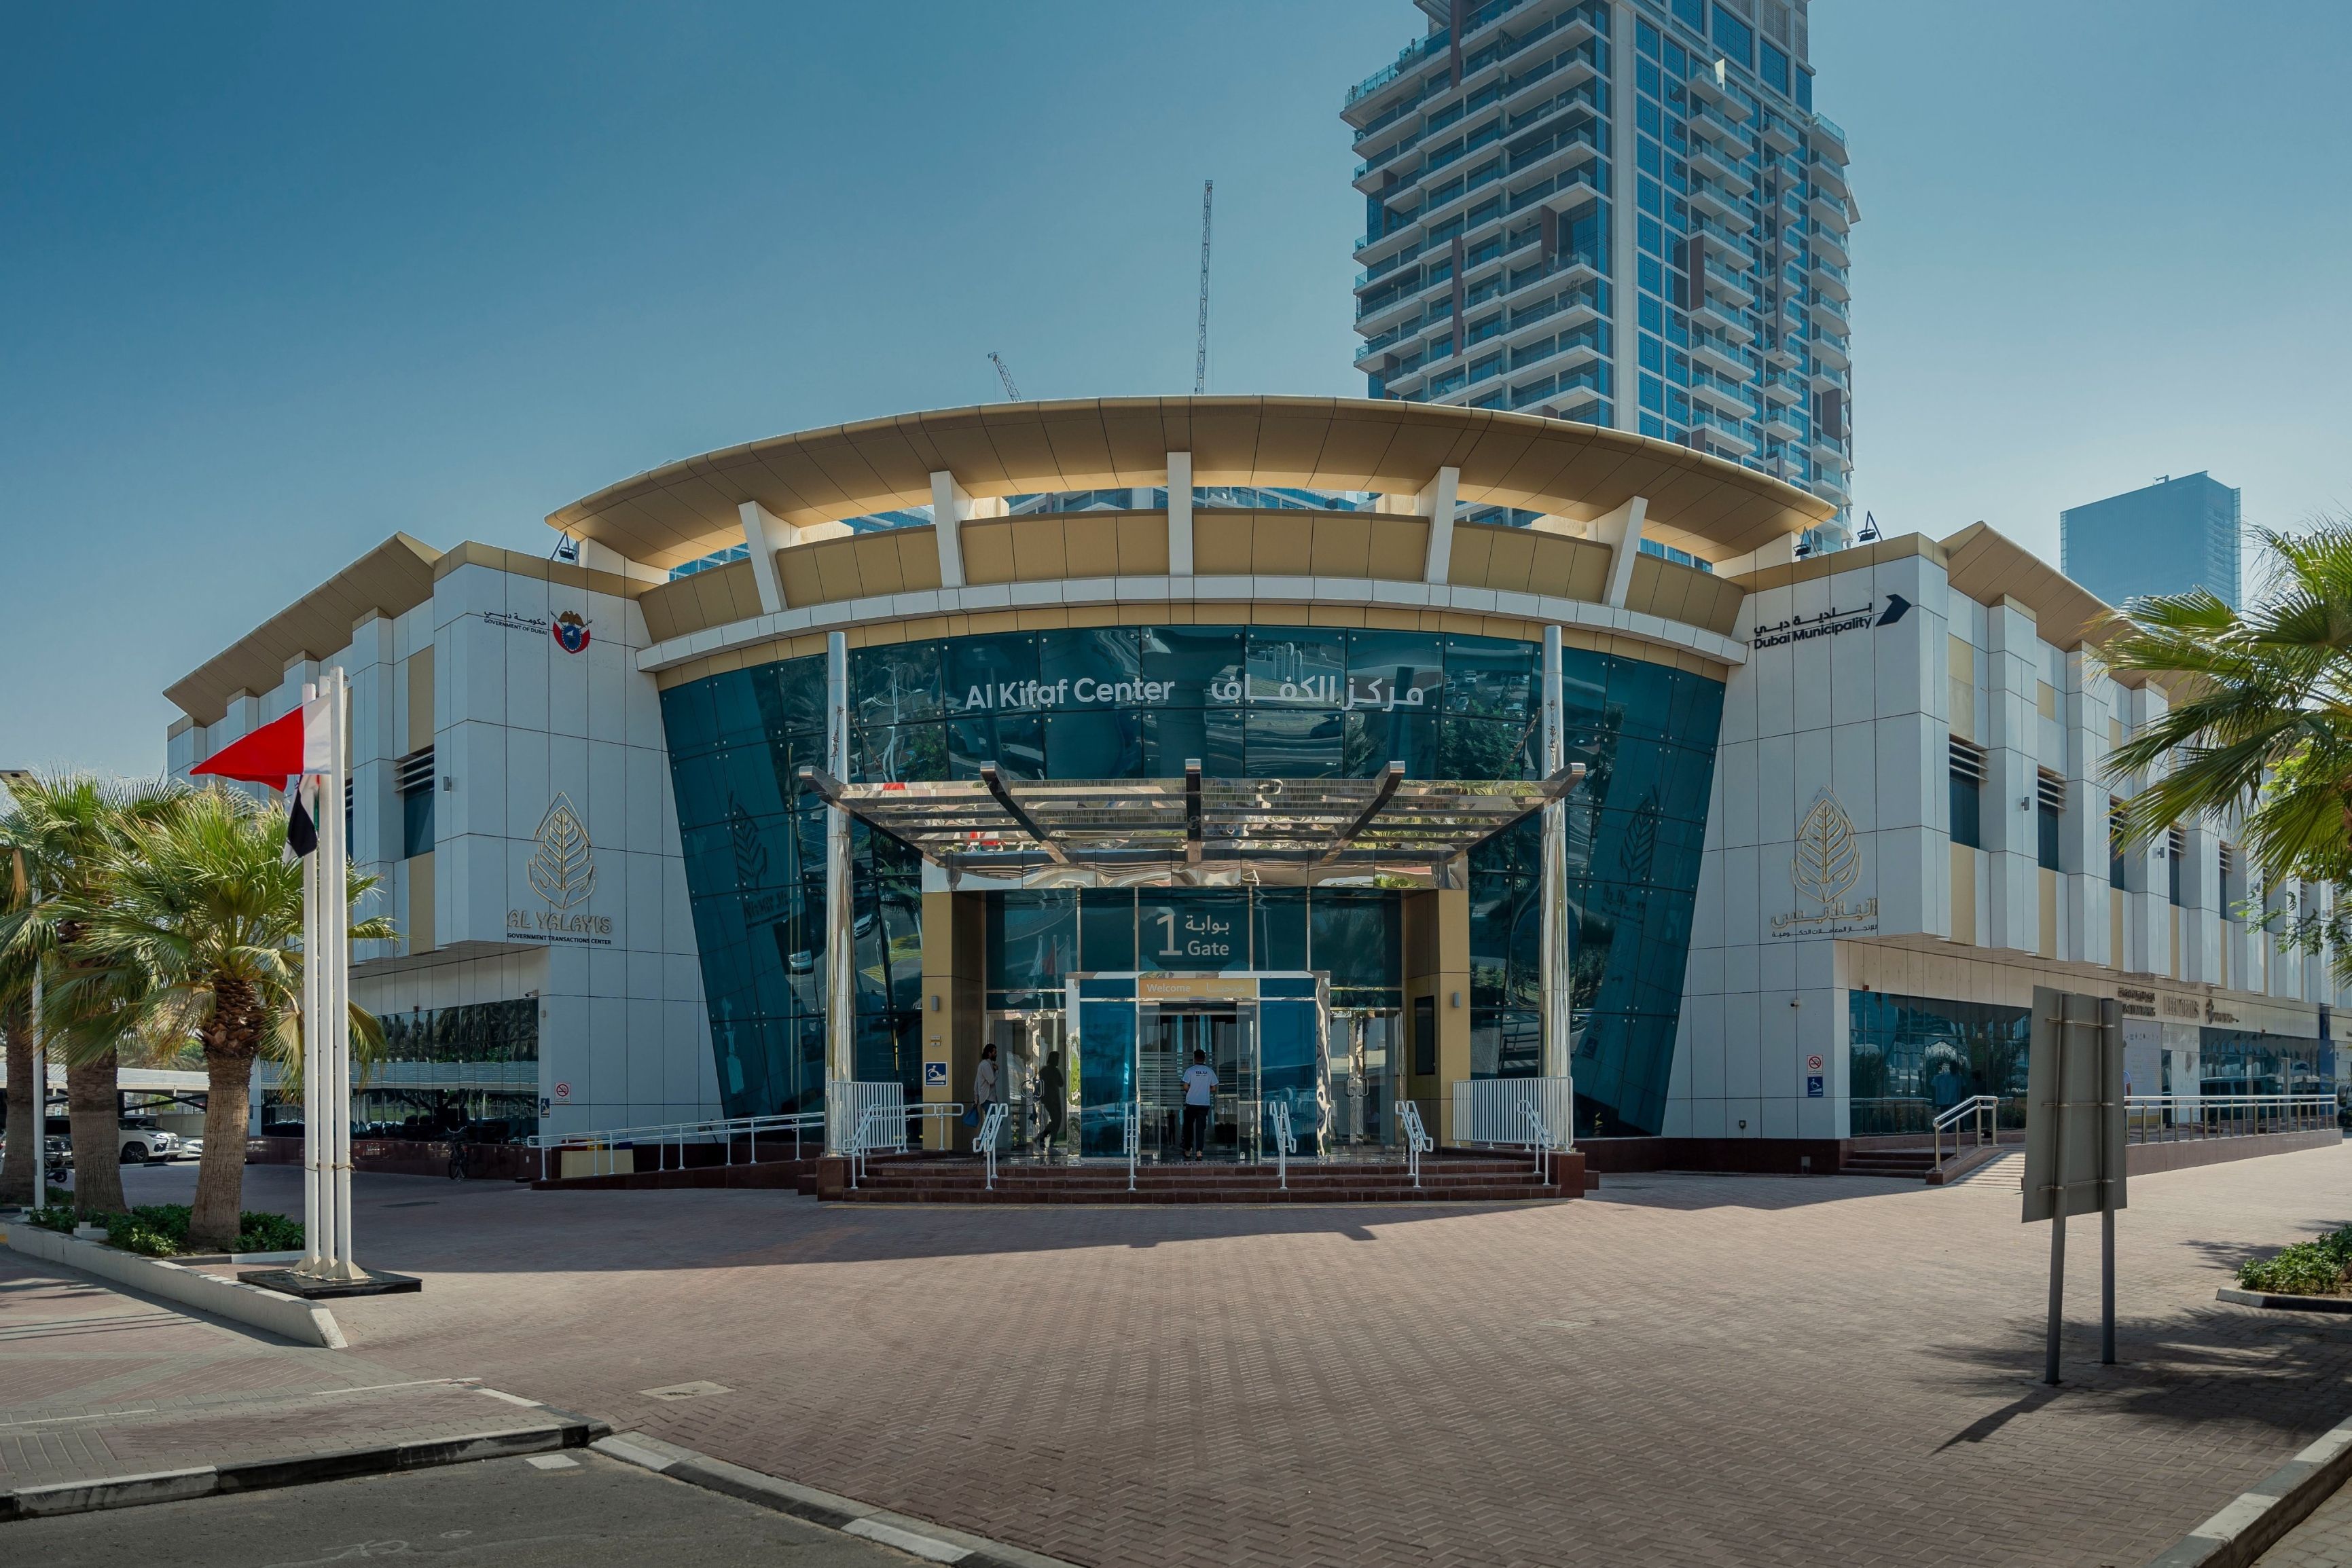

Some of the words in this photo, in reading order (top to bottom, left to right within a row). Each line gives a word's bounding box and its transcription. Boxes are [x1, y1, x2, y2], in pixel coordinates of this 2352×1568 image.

[484, 611, 512, 621] دبي
[514, 613, 547, 625] حكومة
[484, 618, 522, 630] GOVERNMENT
[530, 627, 547, 636] DUBAI
[1754, 620, 1790, 637] دبي
[1754, 632, 1790, 650] Dubai
[1793, 617, 1872, 642] Municipality
[965, 684, 993, 710] Al
[999, 679, 1068, 708] Kifaf
[1074, 678, 1175, 704] Center
[1341, 677, 1424, 712] مركز
[507, 909, 532, 928] AL
[535, 911, 612, 934] YALAYIS
[1185, 915, 1230, 935] بوابة
[507, 932, 547, 941] GOVERNMENT
[547, 935, 590, 943] TRANSACTIONS
[1157, 914, 1183, 956] 1
[1187, 940, 1230, 956] Gate
[1146, 983, 1191, 993] Welcome
